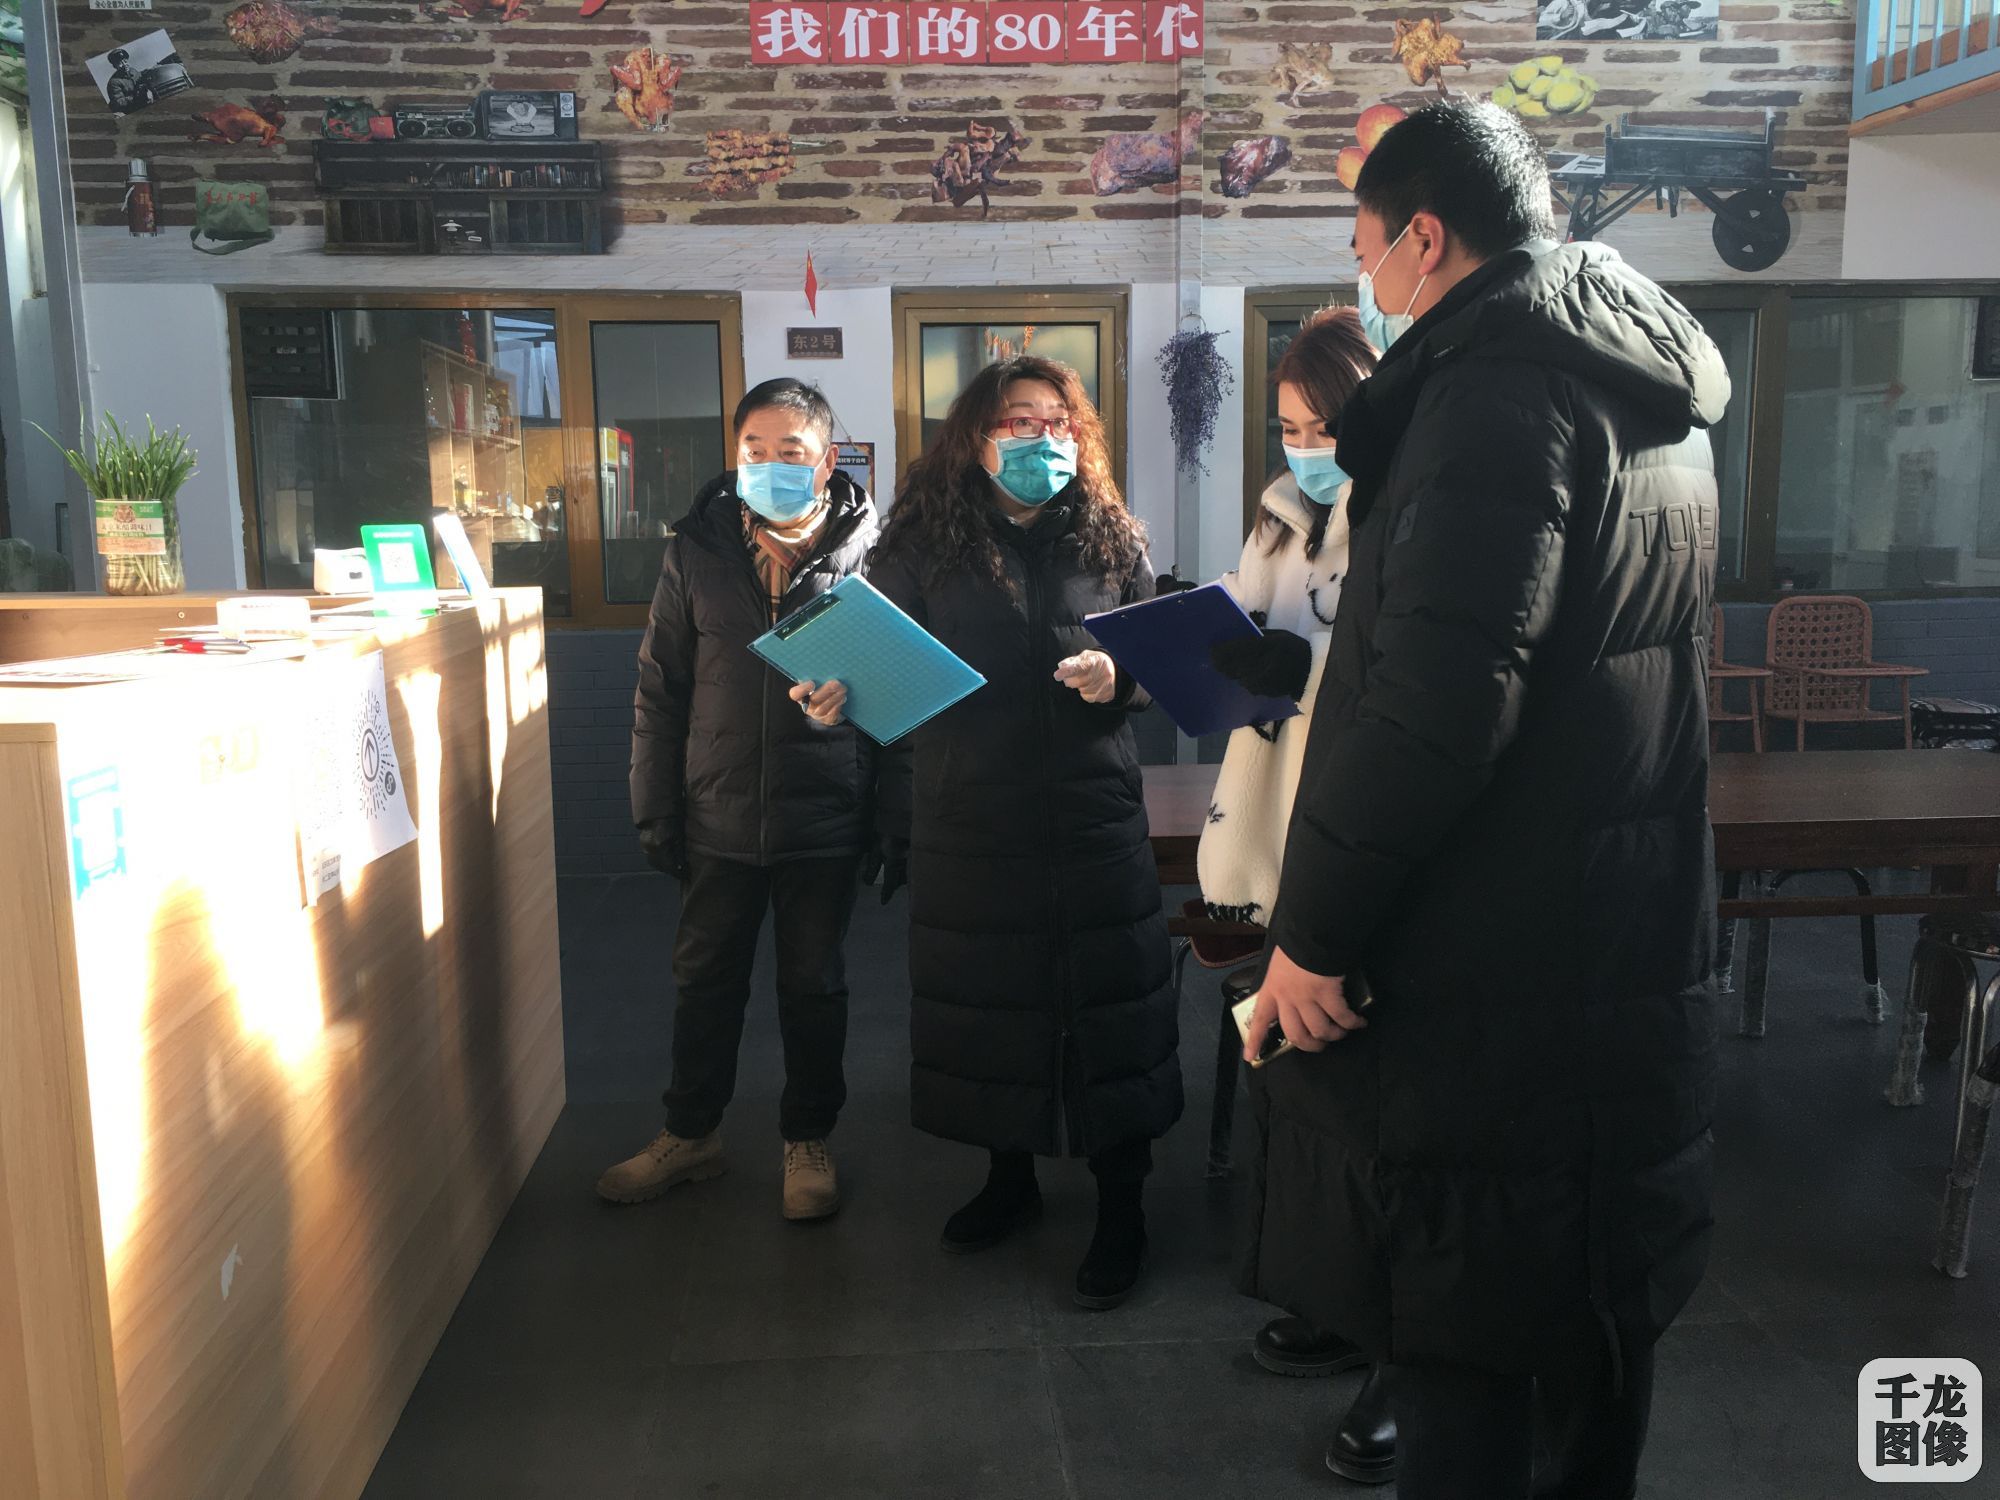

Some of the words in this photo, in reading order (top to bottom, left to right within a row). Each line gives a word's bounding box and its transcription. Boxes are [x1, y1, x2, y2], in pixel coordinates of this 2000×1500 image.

[756, 6, 1201, 59] 我们的80年代
[792, 334, 837, 350] 东2号
